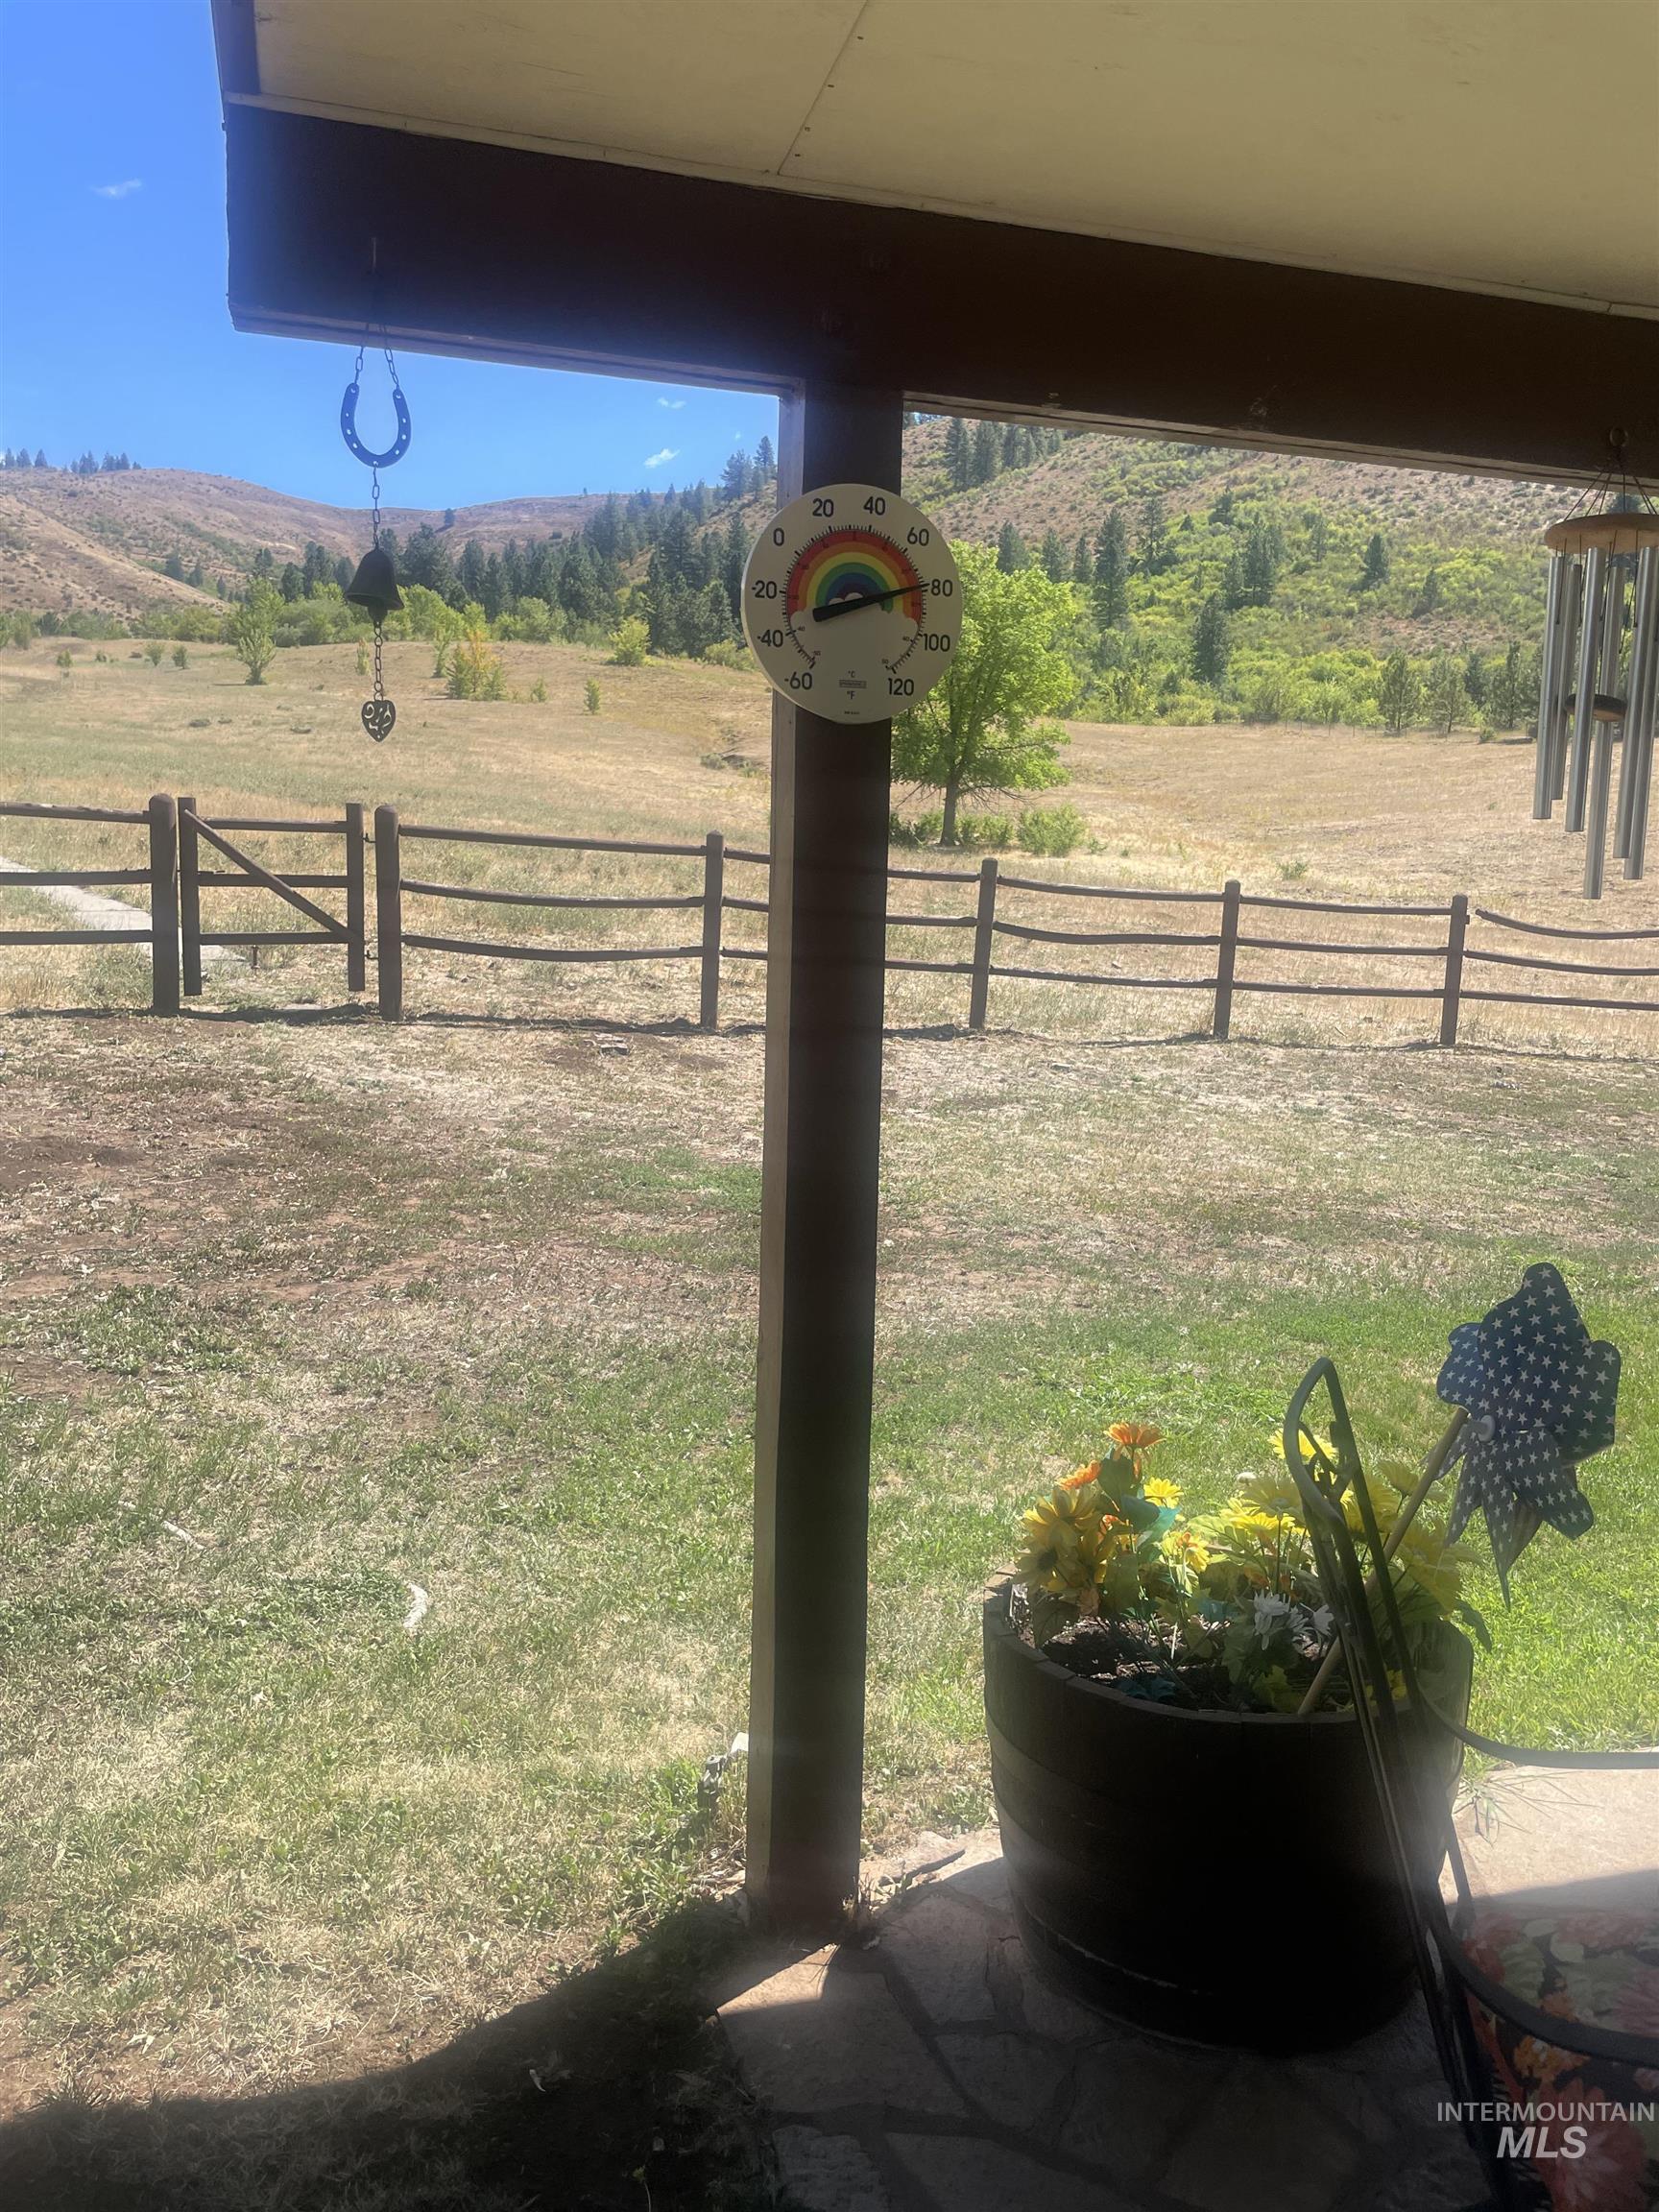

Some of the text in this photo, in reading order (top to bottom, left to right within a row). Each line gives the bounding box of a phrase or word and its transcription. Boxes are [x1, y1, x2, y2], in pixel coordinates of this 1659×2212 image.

[812, 498, 834, 517] 20
[863, 496, 886, 516] 40
[773, 527, 784, 546] 0
[907, 527, 930, 546] 60
[751, 580, 778, 599] -20
[930, 579, 953, 597] 80
[757, 629, 783, 648] -40
[924, 633, 950, 653] 100
[783, 671, 813, 690] -60
[887, 677, 915, 696] 120
